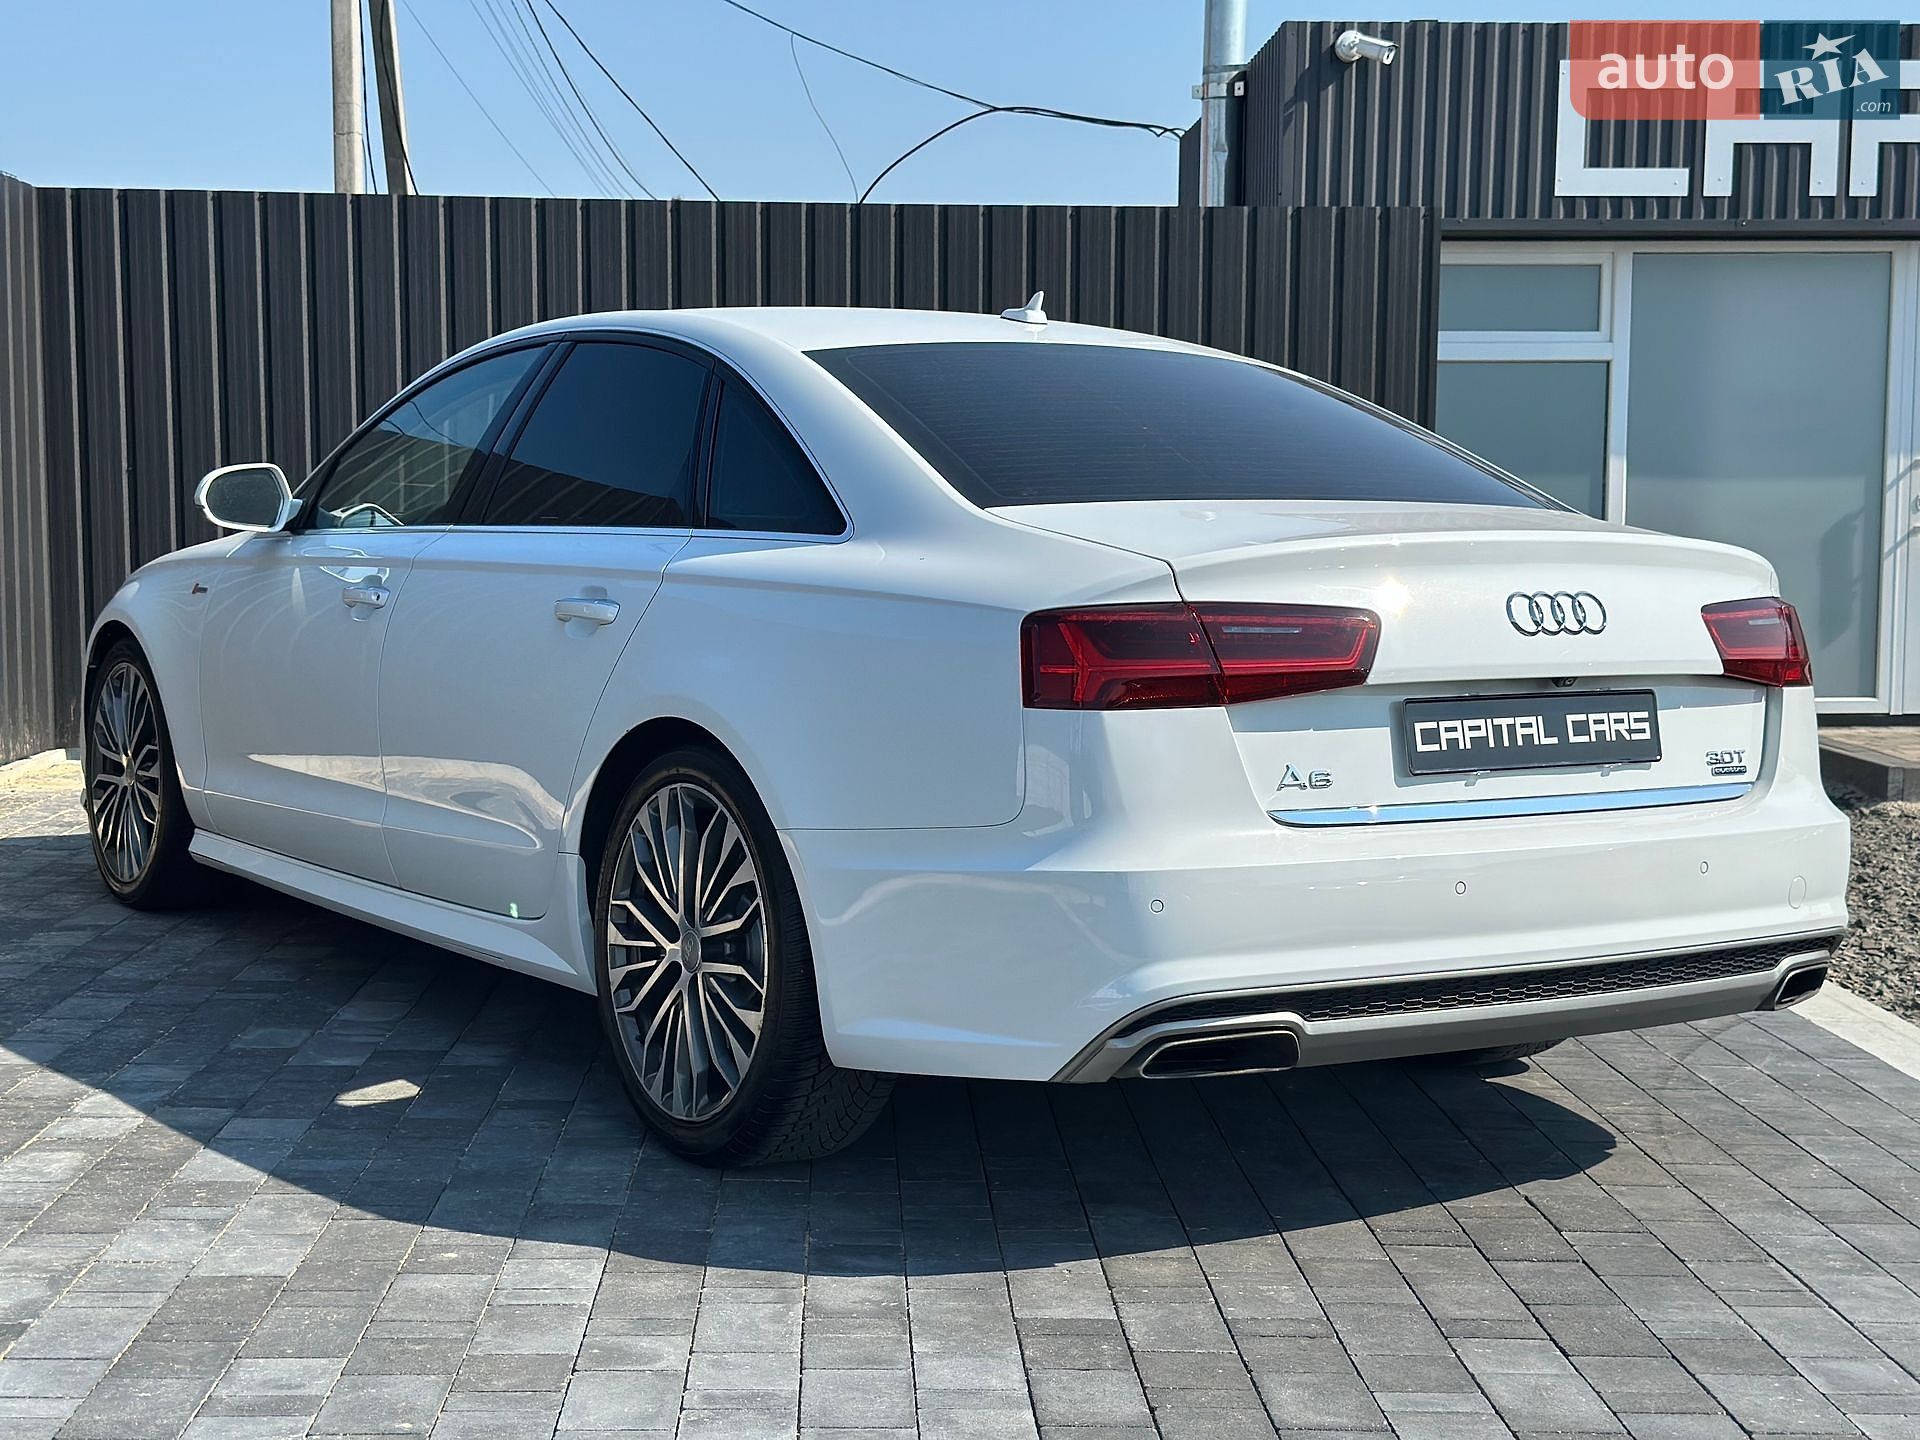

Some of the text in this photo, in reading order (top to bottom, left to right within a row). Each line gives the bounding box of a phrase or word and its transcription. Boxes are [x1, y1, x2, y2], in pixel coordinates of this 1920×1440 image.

[1414, 711, 1651, 752] CAPITAL CARS
[1276, 763, 1333, 791] A6
